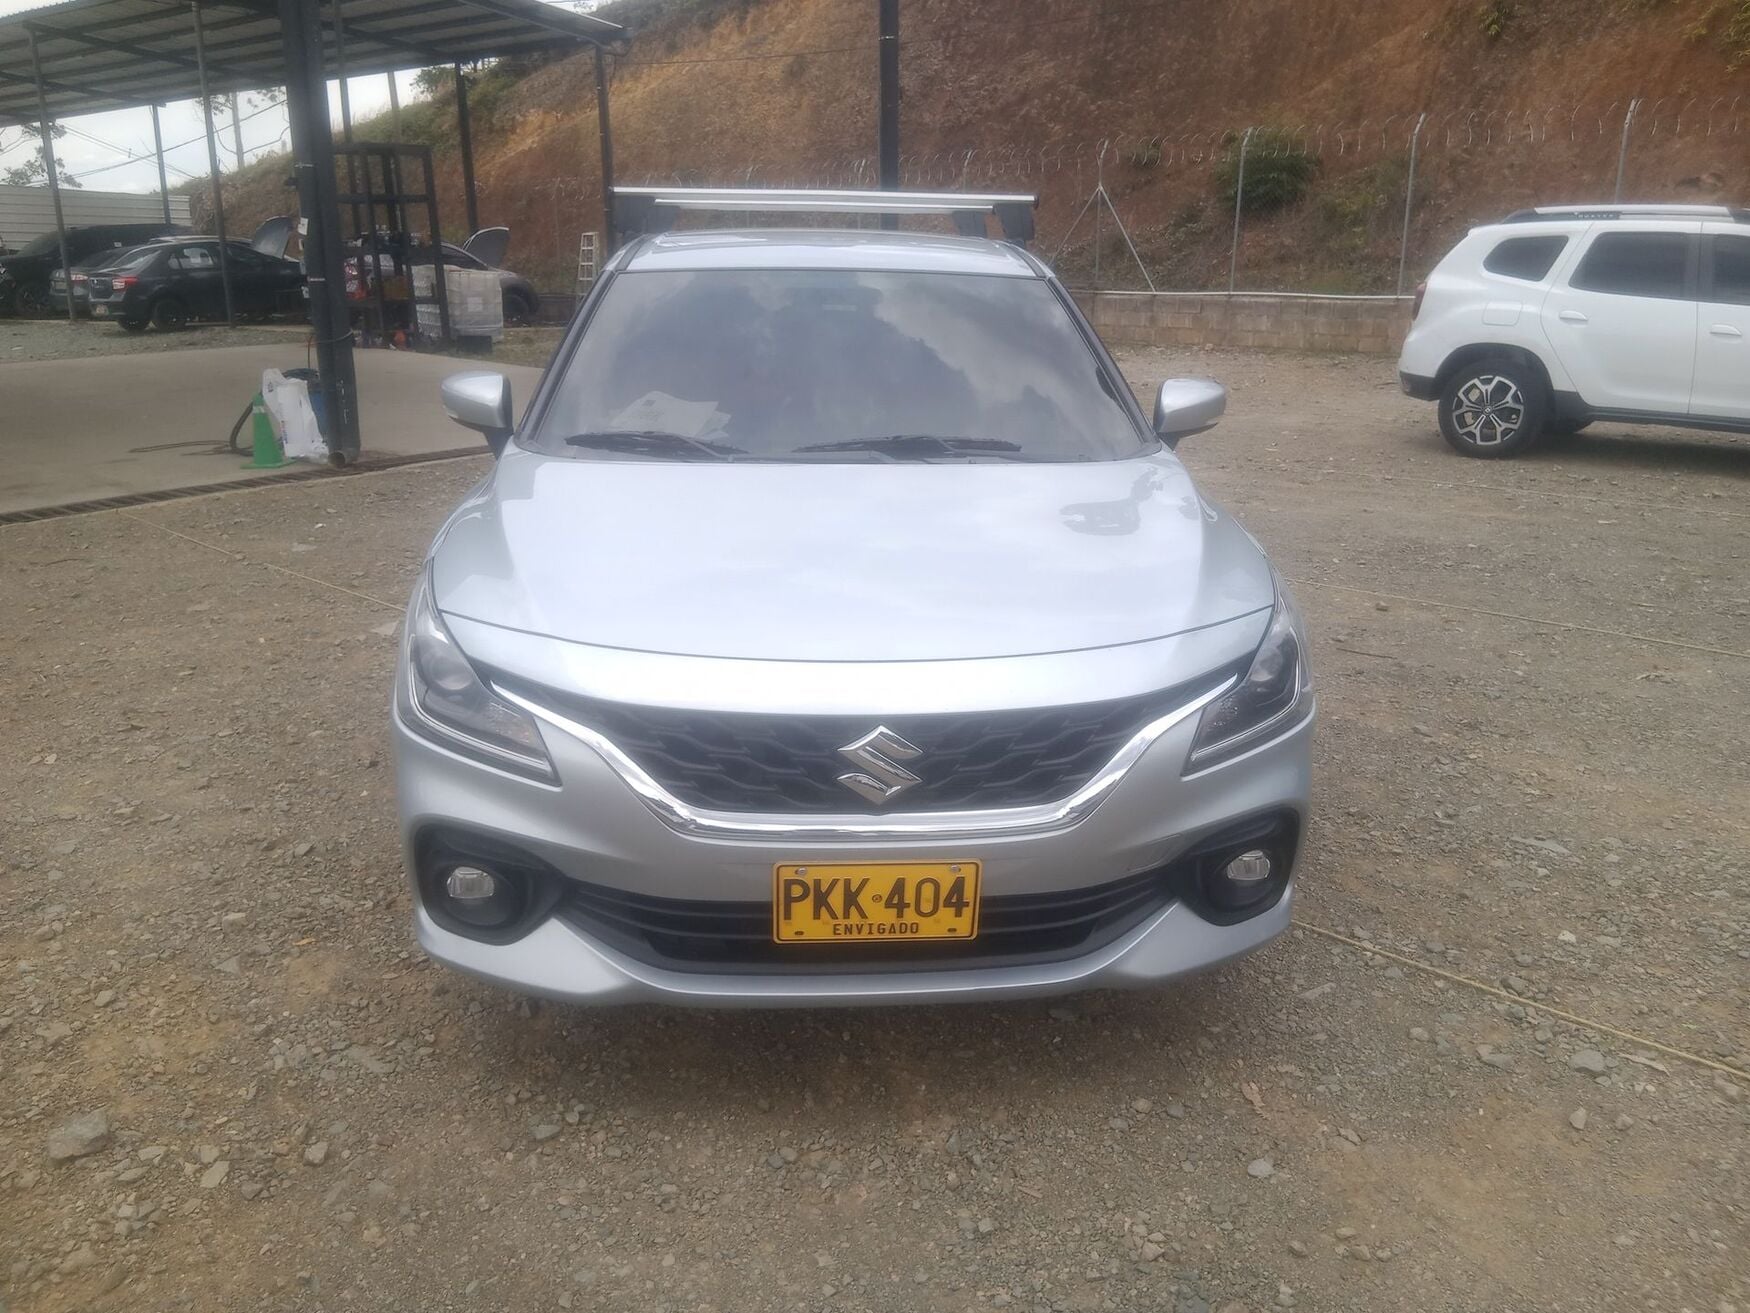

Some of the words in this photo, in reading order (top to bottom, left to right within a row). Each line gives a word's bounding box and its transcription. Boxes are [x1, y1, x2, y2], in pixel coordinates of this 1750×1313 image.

[783, 877, 871, 921] PKK
[884, 876, 970, 919] 404
[833, 922, 920, 936] ENVIGADO
